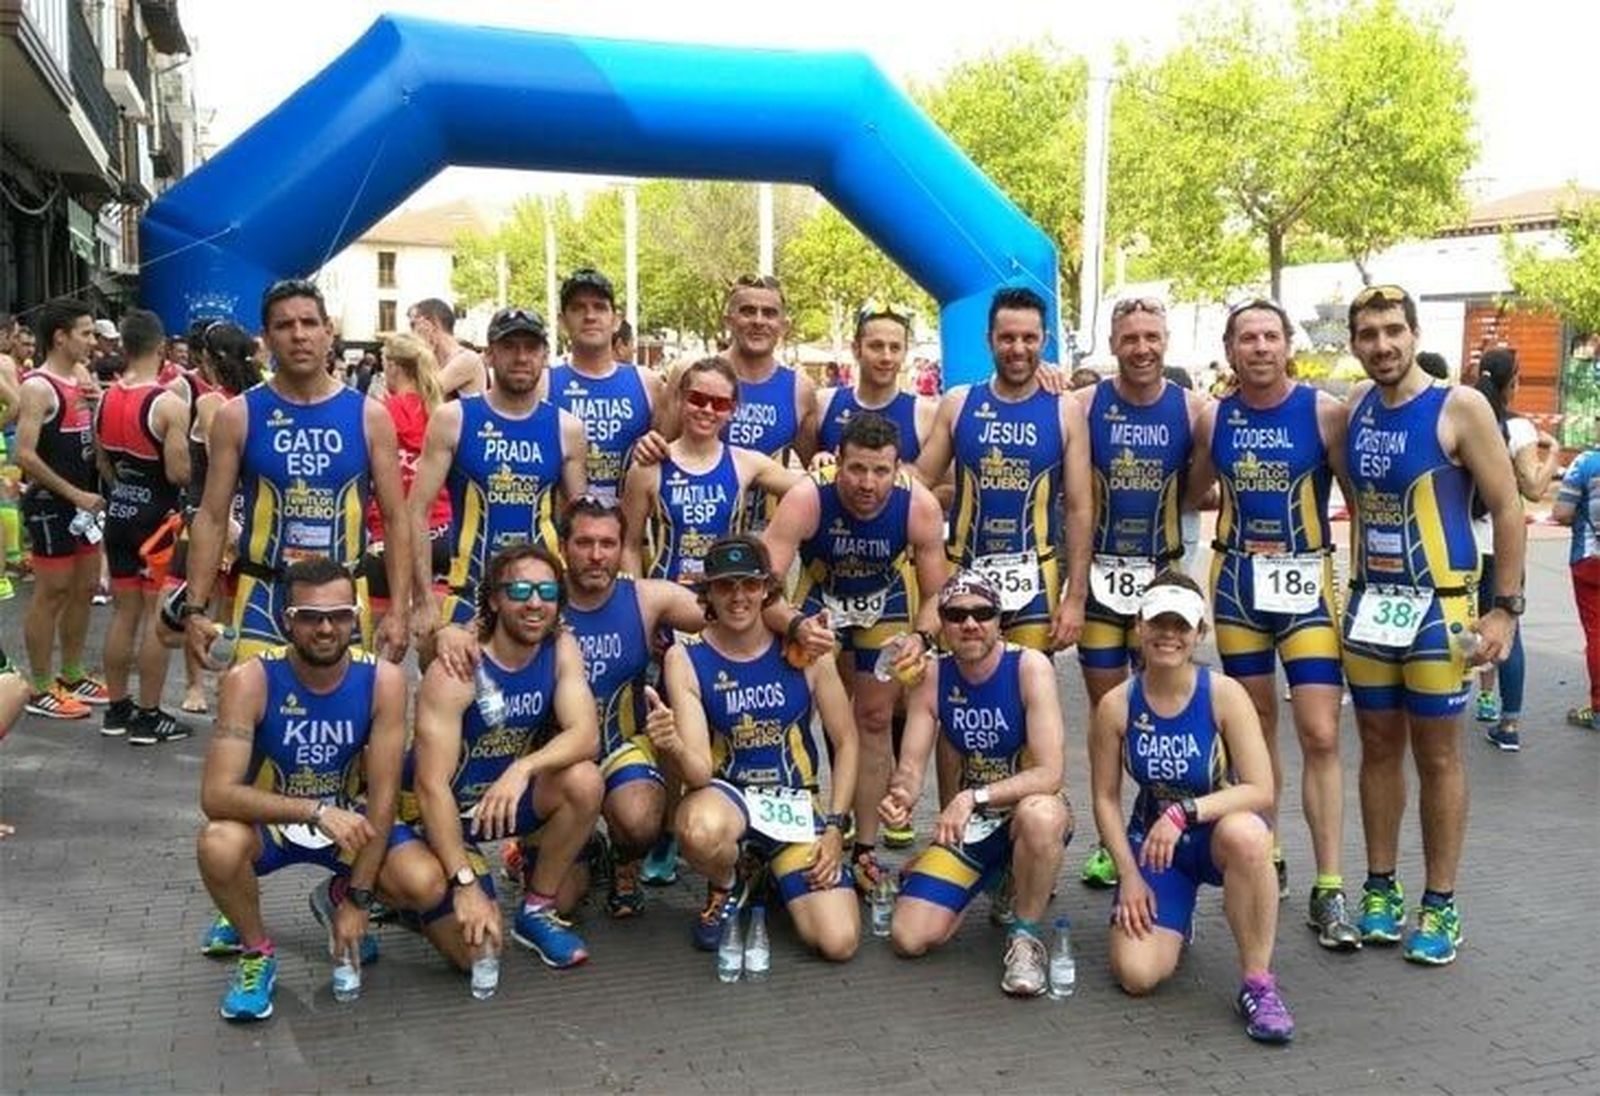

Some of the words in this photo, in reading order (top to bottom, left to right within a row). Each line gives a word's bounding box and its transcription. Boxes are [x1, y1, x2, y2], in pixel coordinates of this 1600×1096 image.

[571, 398, 633, 420] MATIAS
[273, 428, 343, 453] GATO
[585, 420, 621, 442] ESP
[728, 424, 764, 444] ESP
[979, 422, 1038, 447] JESUS
[1110, 424, 1169, 446] MERINO
[1233, 428, 1294, 449] CODESAL
[1355, 428, 1408, 454] CRISTIAN
[484, 439, 544, 463] PRADA
[287, 453, 330, 475] ESP
[1360, 453, 1391, 478] ESP
[671, 484, 727, 505] MATILLA
[981, 477, 1029, 492] DUERO
[1110, 476, 1162, 491] DUERO
[1235, 479, 1290, 492] DUERO
[109, 501, 138, 519] ESP
[284, 505, 334, 519] DUERO
[683, 505, 717, 524] ESP
[832, 537, 890, 558] MARTIN
[988, 569, 1032, 592] 35a
[1268, 570, 1317, 596] 18e
[1373, 600, 1420, 627] 38f
[577, 632, 622, 659] ORADO
[583, 661, 607, 683] SP
[505, 690, 543, 717] VARO
[726, 683, 785, 714] MARCOS
[953, 707, 1010, 731] RODA
[282, 720, 354, 746] KINI
[964, 731, 999, 749] ESP
[296, 744, 339, 765] ESP
[1136, 733, 1201, 758] GARCIA
[1148, 759, 1189, 780] ESP
[759, 799, 807, 827] 38c
